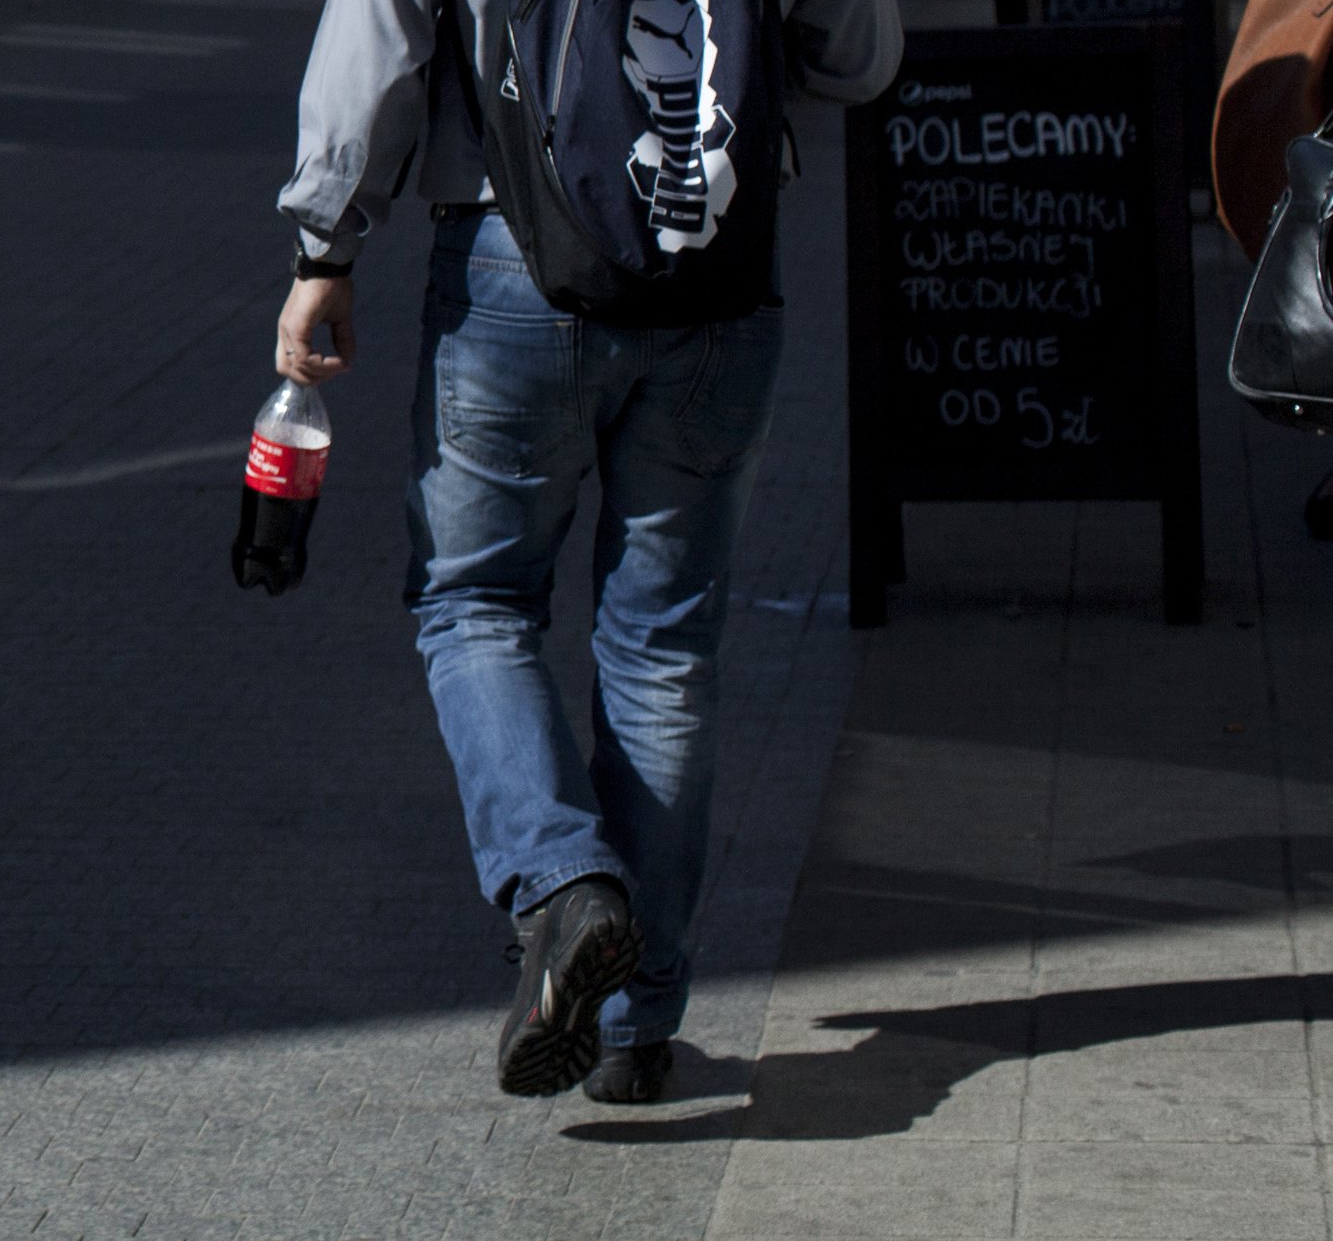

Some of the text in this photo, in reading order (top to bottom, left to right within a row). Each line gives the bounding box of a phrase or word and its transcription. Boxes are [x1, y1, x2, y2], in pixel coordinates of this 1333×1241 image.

[646, 77, 708, 233] PUMA
[885, 109, 1138, 167] POLECAMY:
[894, 175, 1127, 231] ZAPIEKANKI
[898, 273, 1102, 319] PRODUKCJI
[903, 334, 939, 374] W
[938, 387, 1001, 427] OD
[1015, 385, 1054, 450] 5
